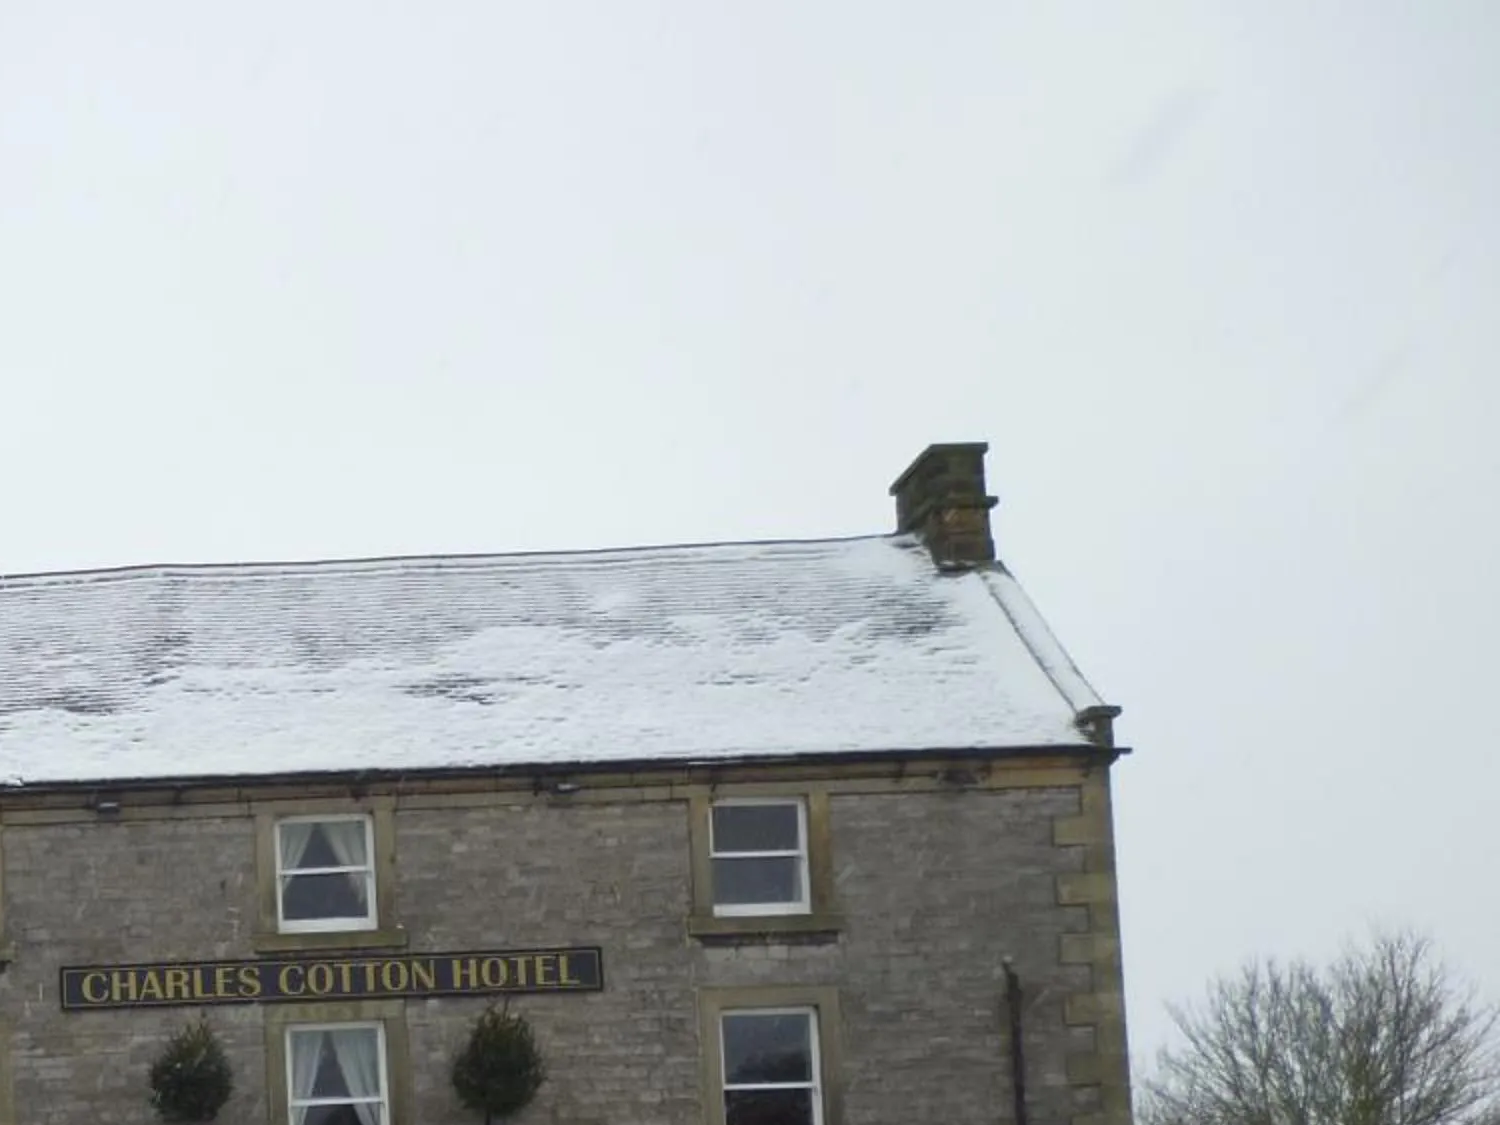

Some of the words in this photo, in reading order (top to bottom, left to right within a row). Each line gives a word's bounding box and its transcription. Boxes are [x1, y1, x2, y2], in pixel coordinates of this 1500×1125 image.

[81, 966, 261, 1003] CHARLES
[279, 959, 435, 995] COTTON
[452, 955, 581, 989] HOTEL
